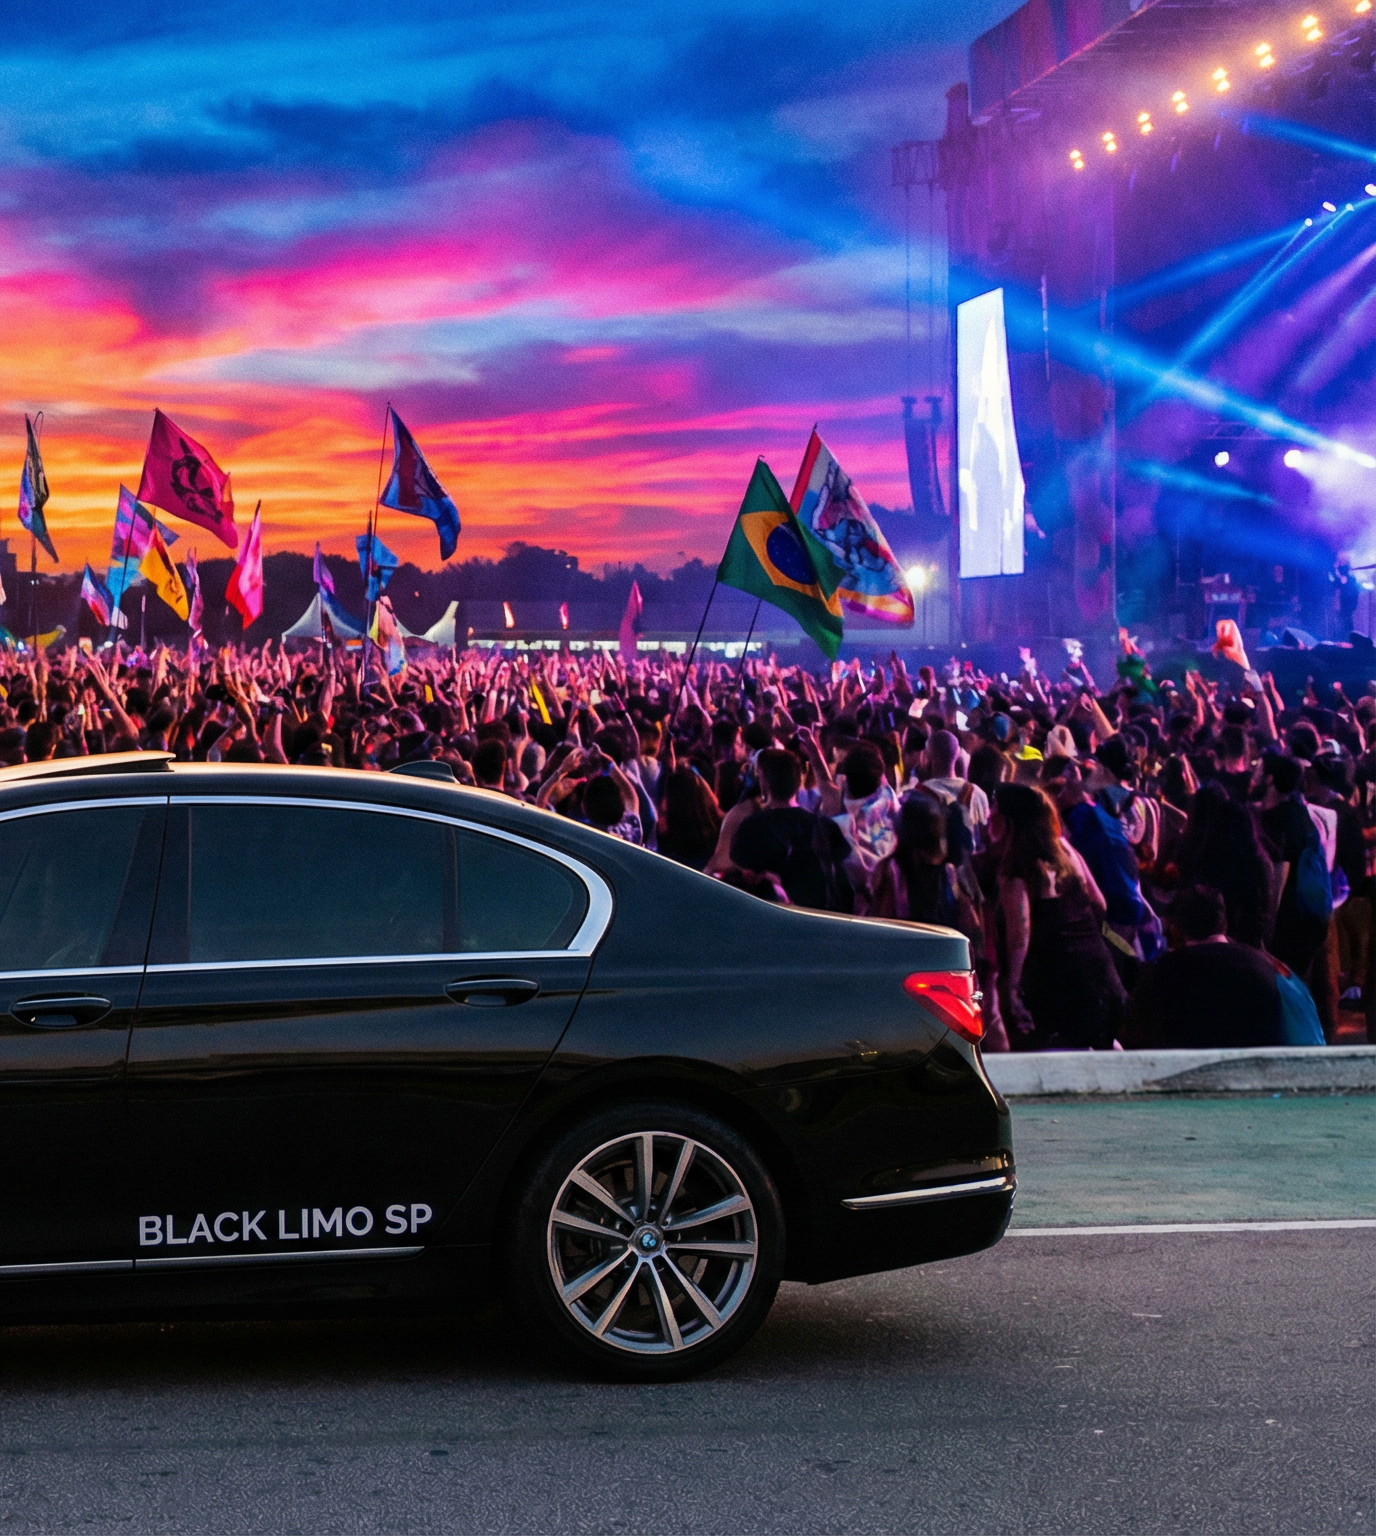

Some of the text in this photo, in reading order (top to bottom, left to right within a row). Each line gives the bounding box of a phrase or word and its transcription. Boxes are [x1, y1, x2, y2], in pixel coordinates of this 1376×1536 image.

[139, 1203, 432, 1246] BLACK LIMO SP
